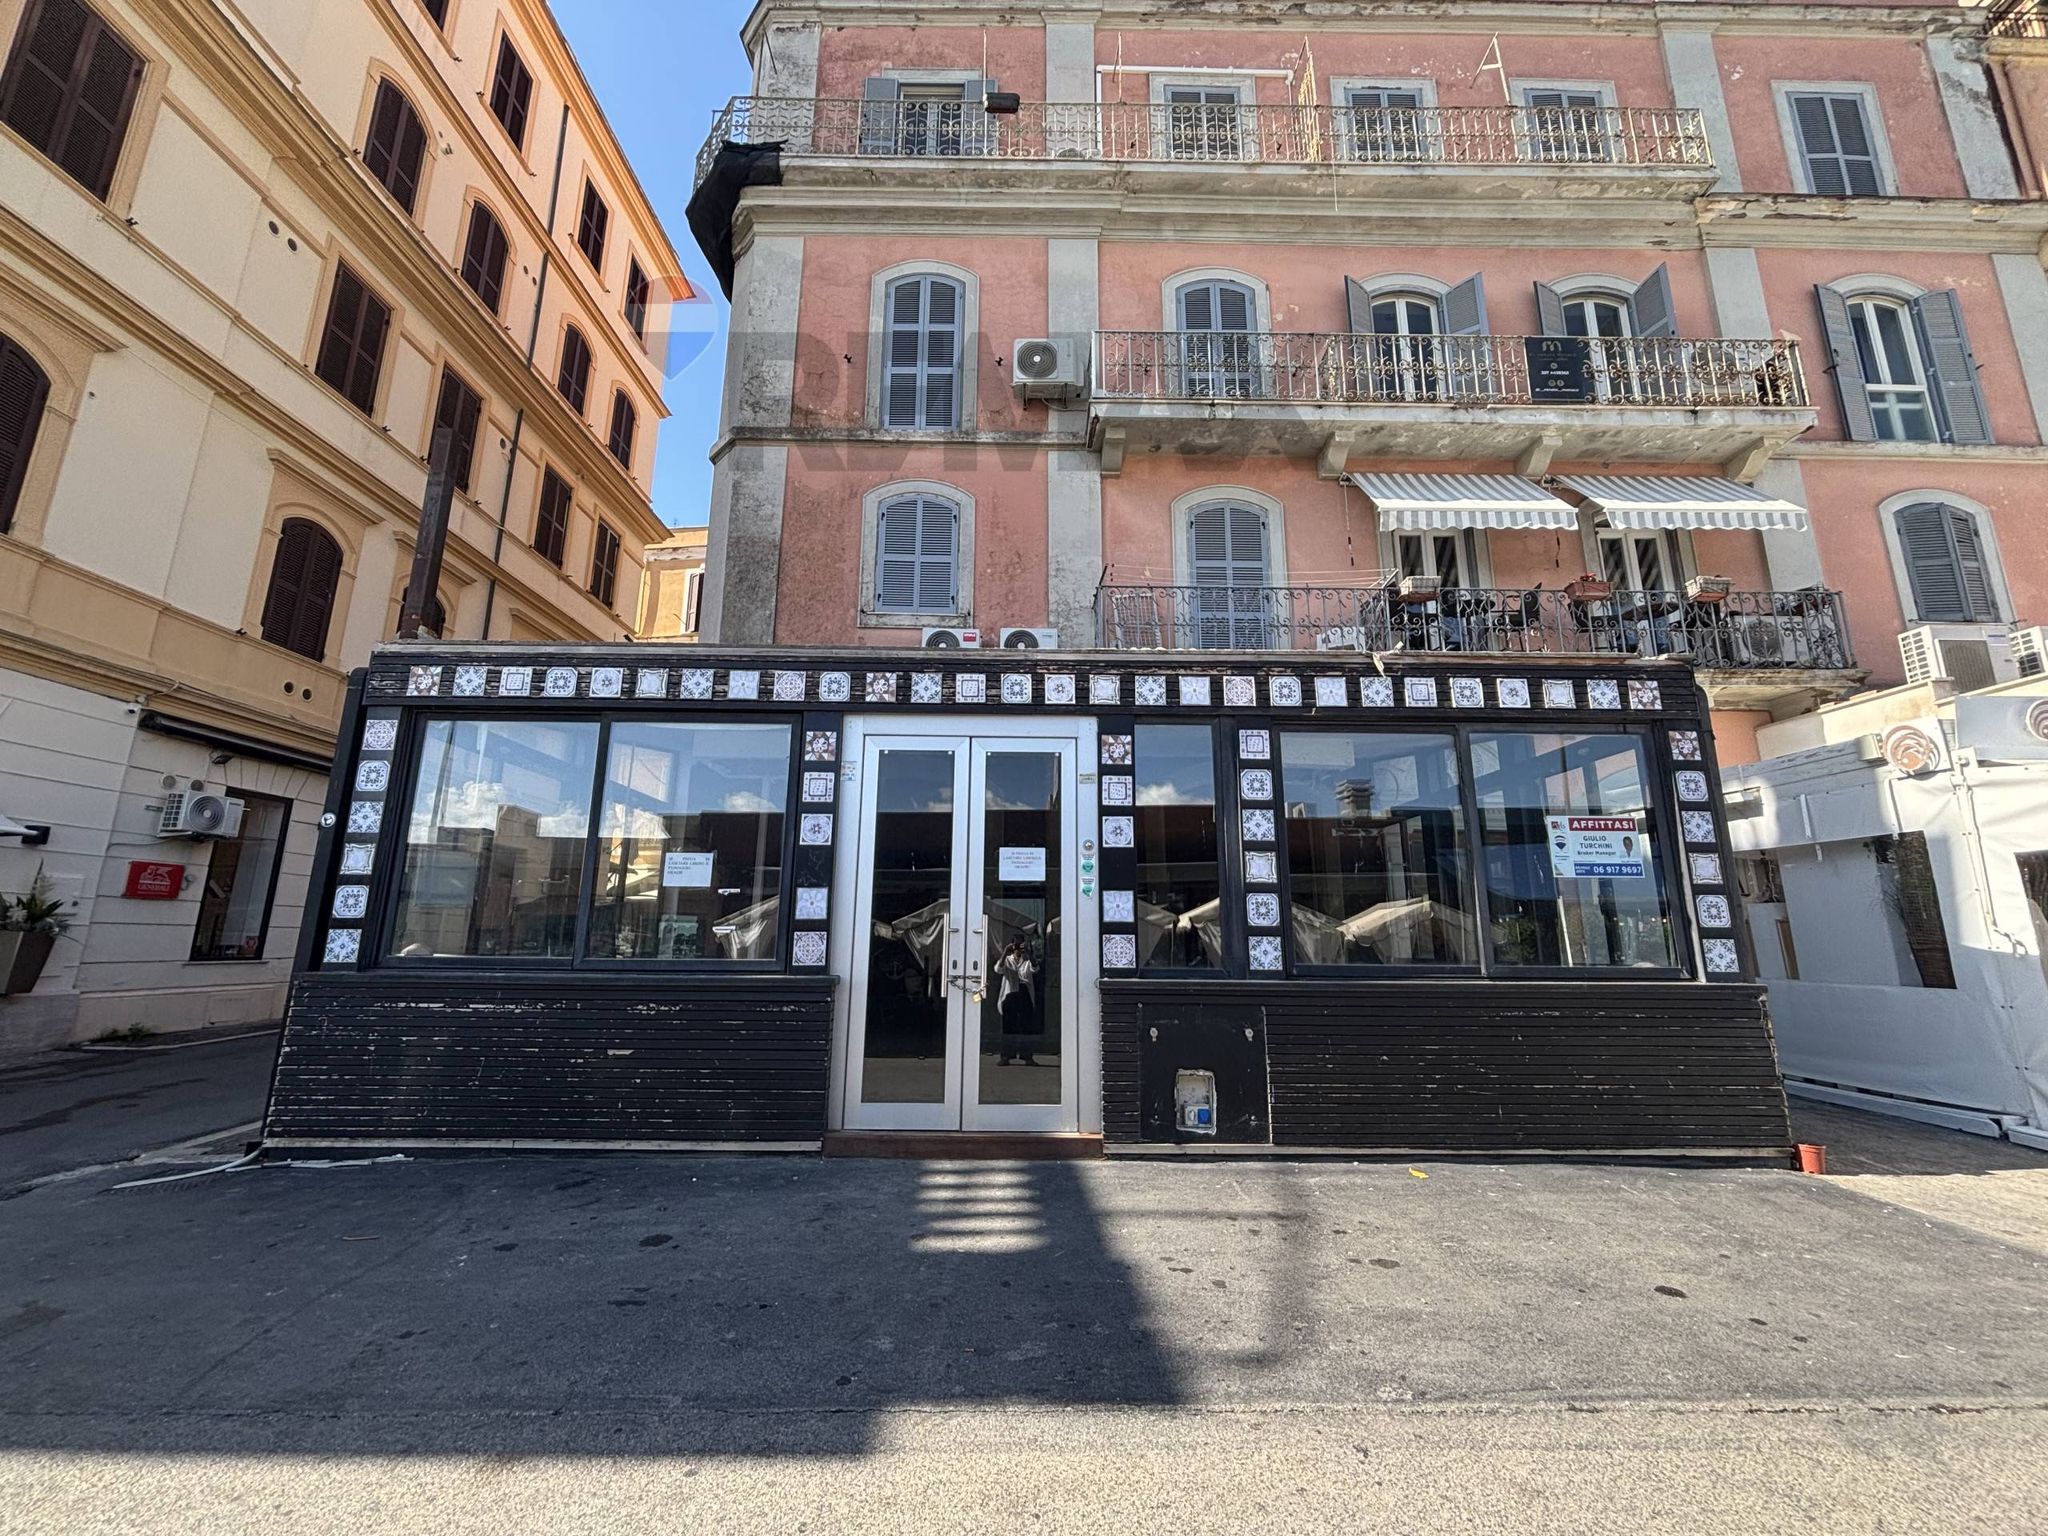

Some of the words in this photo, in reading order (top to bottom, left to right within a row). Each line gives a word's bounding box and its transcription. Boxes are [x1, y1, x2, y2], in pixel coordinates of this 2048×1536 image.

[1572, 820, 1634, 829] AFFITTASI
[1593, 865, 1605, 874] 06
[1606, 865, 1620, 874] 917
[1621, 865, 1642, 874] 9697
